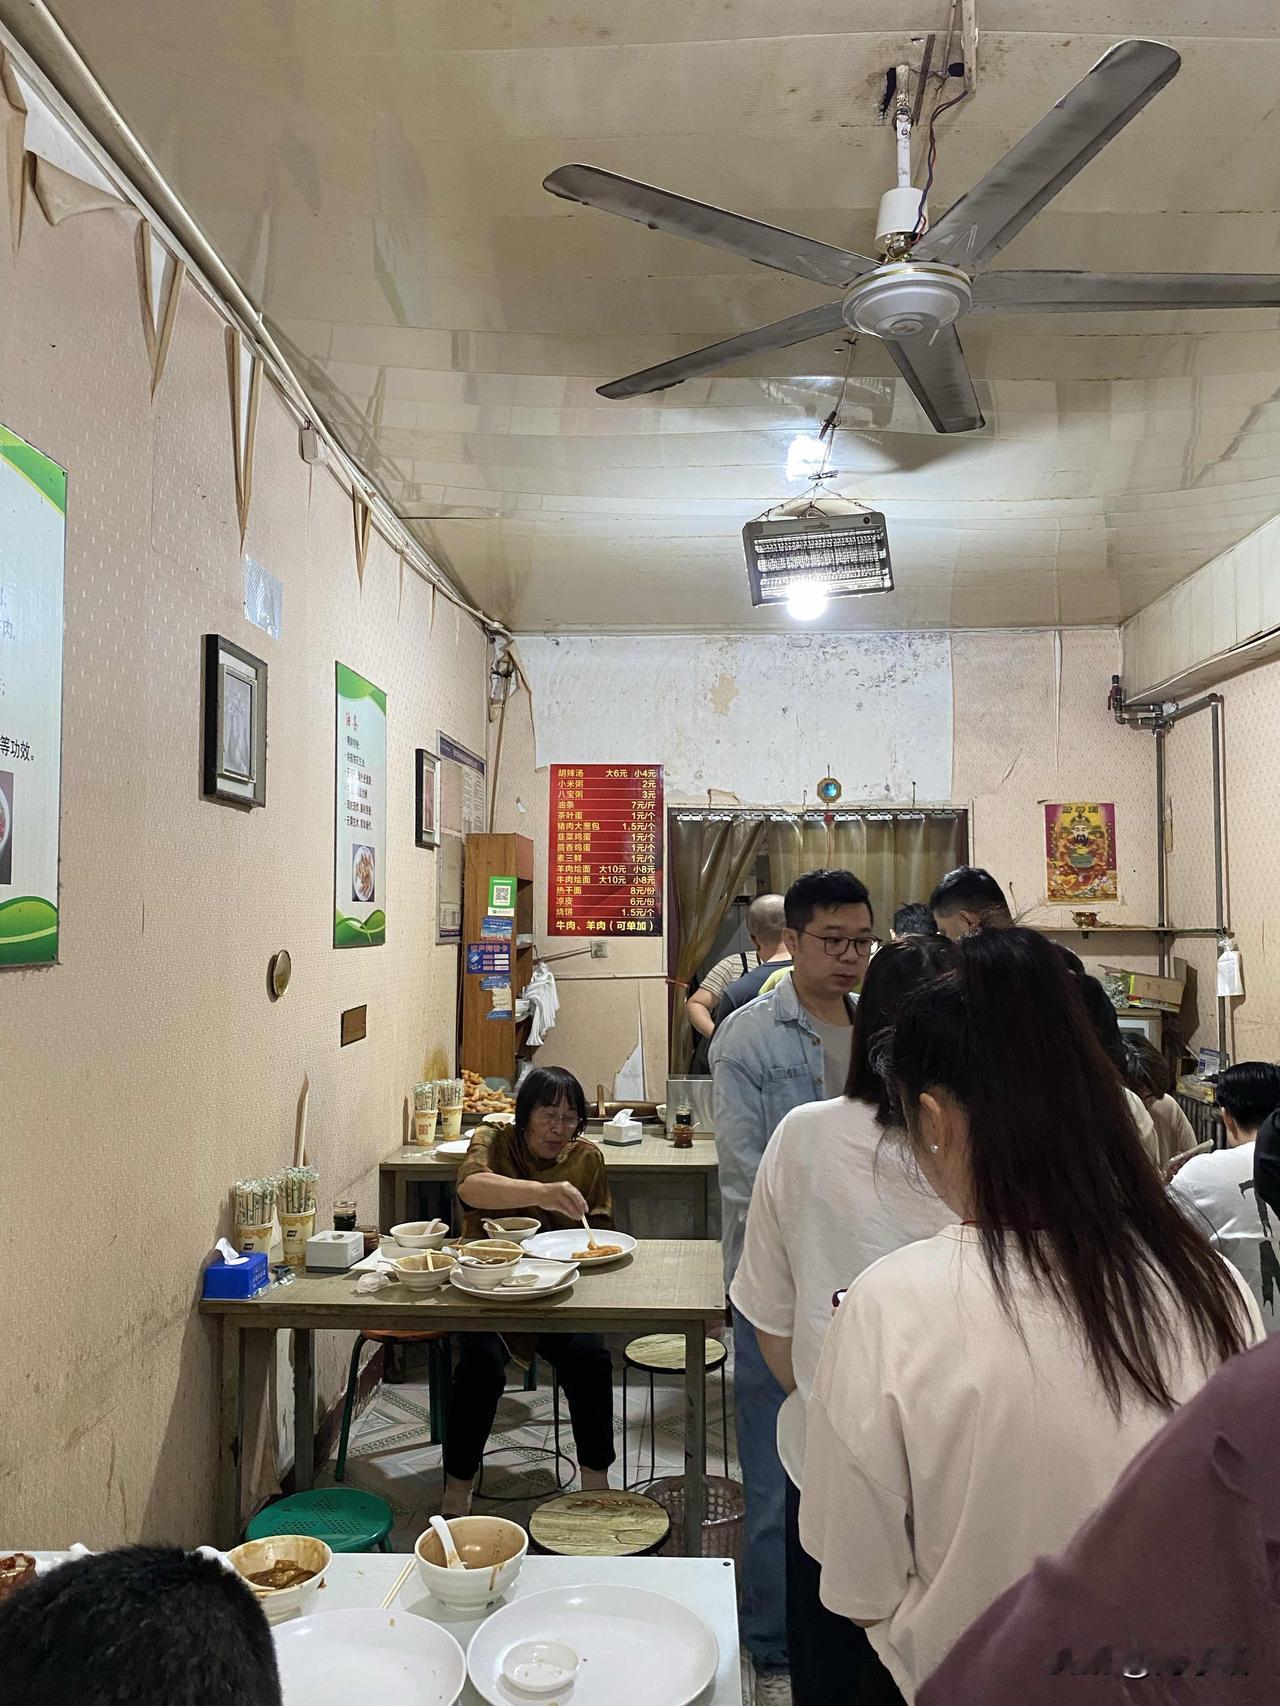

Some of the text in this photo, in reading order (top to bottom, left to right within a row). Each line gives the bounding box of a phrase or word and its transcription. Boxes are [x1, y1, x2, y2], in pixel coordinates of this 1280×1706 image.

[0, 735, 34, 761] 等功效。
[558, 769, 656, 777] 胡辣汤 大6元 小4元
[558, 780, 656, 788] 小米粥 2元
[558, 790, 583, 798] 八宝粥
[557, 801, 655, 809] 油条 7元/斤
[632, 812, 655, 820] 1元/个
[557, 822, 600, 830] 猪肉大葱包
[558, 833, 655, 841] 韭菜鸡蛋 1元/个
[631, 844, 655, 852] 1元/个
[631, 855, 655, 863] 1元/个
[557, 865, 655, 874] 羊肉烩面 大10元 小8元
[599, 876, 626, 884] 大10元
[633, 876, 655, 884] 小8元
[557, 886, 656, 895] 热干面 8元/份
[557, 897, 654, 906] 凉皮 6元/份
[622, 909, 654, 917] 1.5元/个
